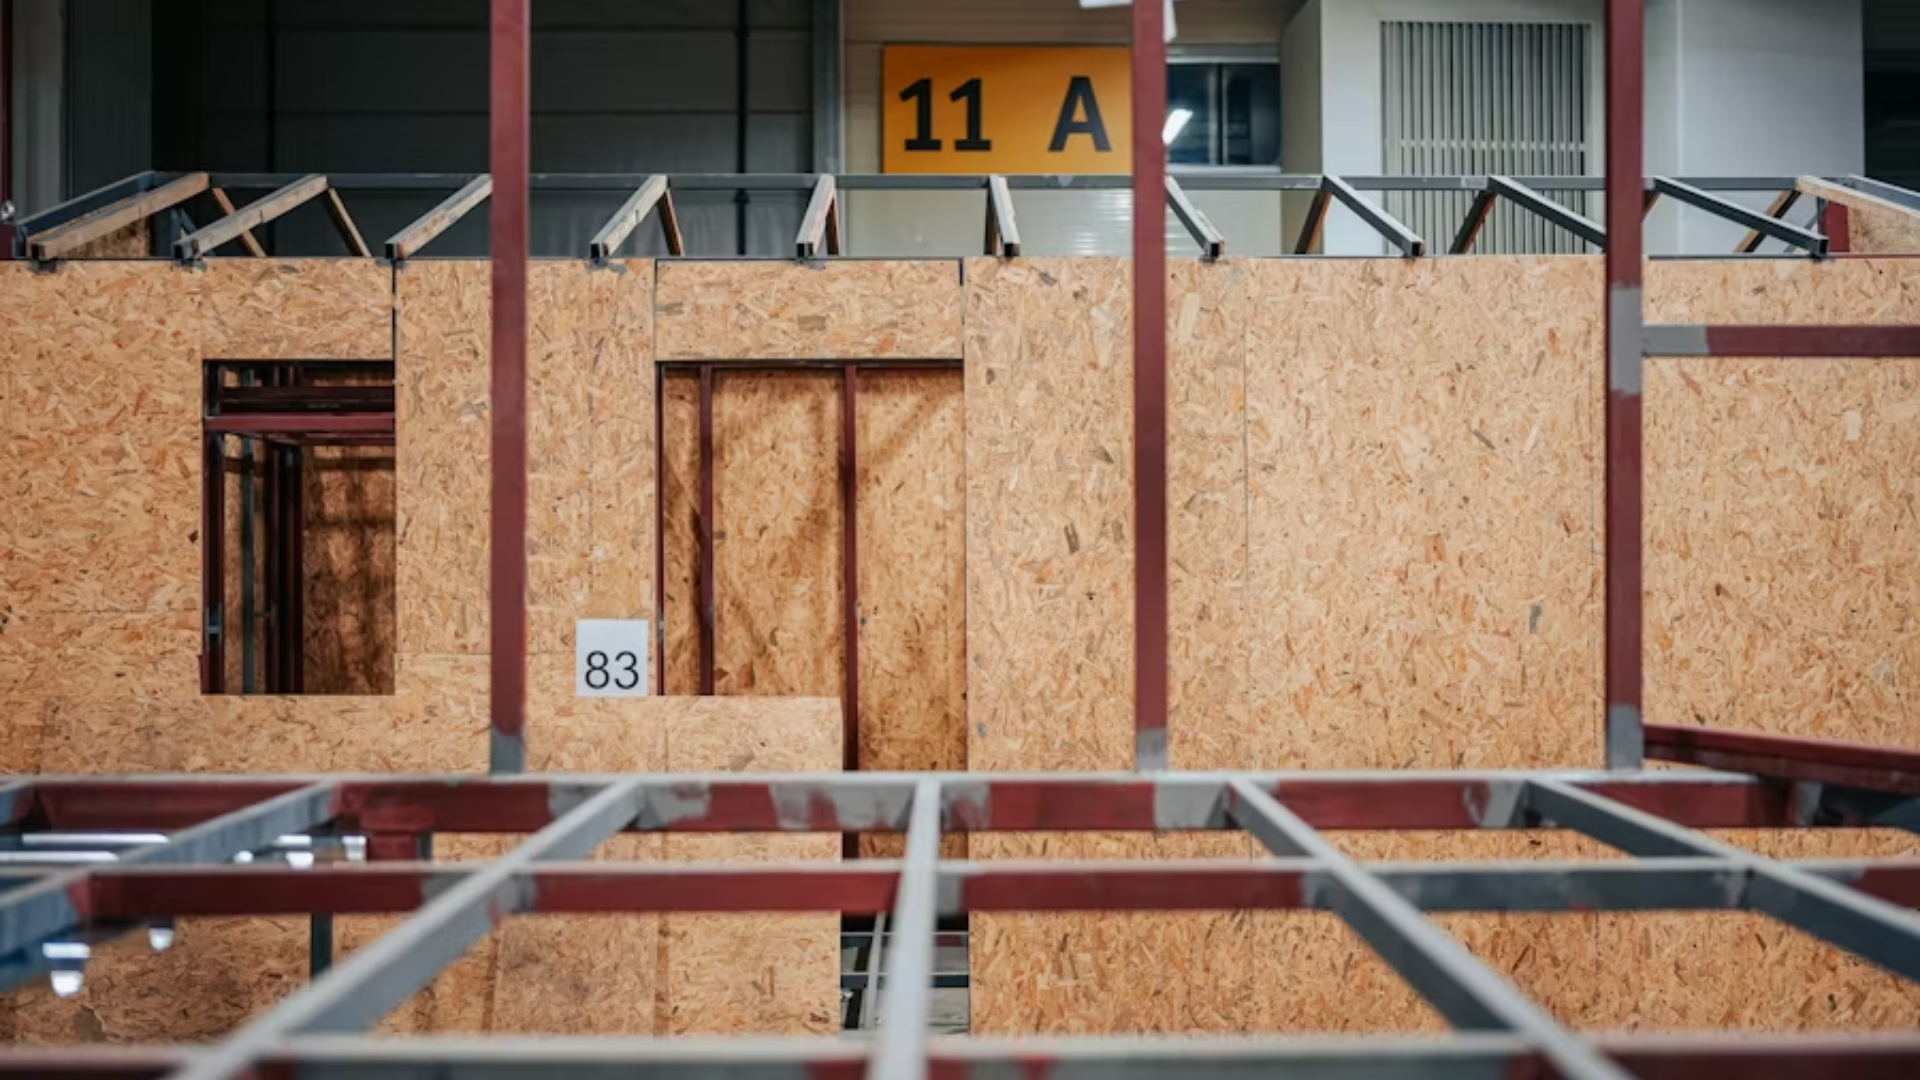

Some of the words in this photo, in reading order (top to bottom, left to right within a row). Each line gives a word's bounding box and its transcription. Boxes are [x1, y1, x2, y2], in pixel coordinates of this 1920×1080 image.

[899, 78, 991, 151] 11
[1048, 75, 1111, 151] A
[585, 650, 639, 690] 83
